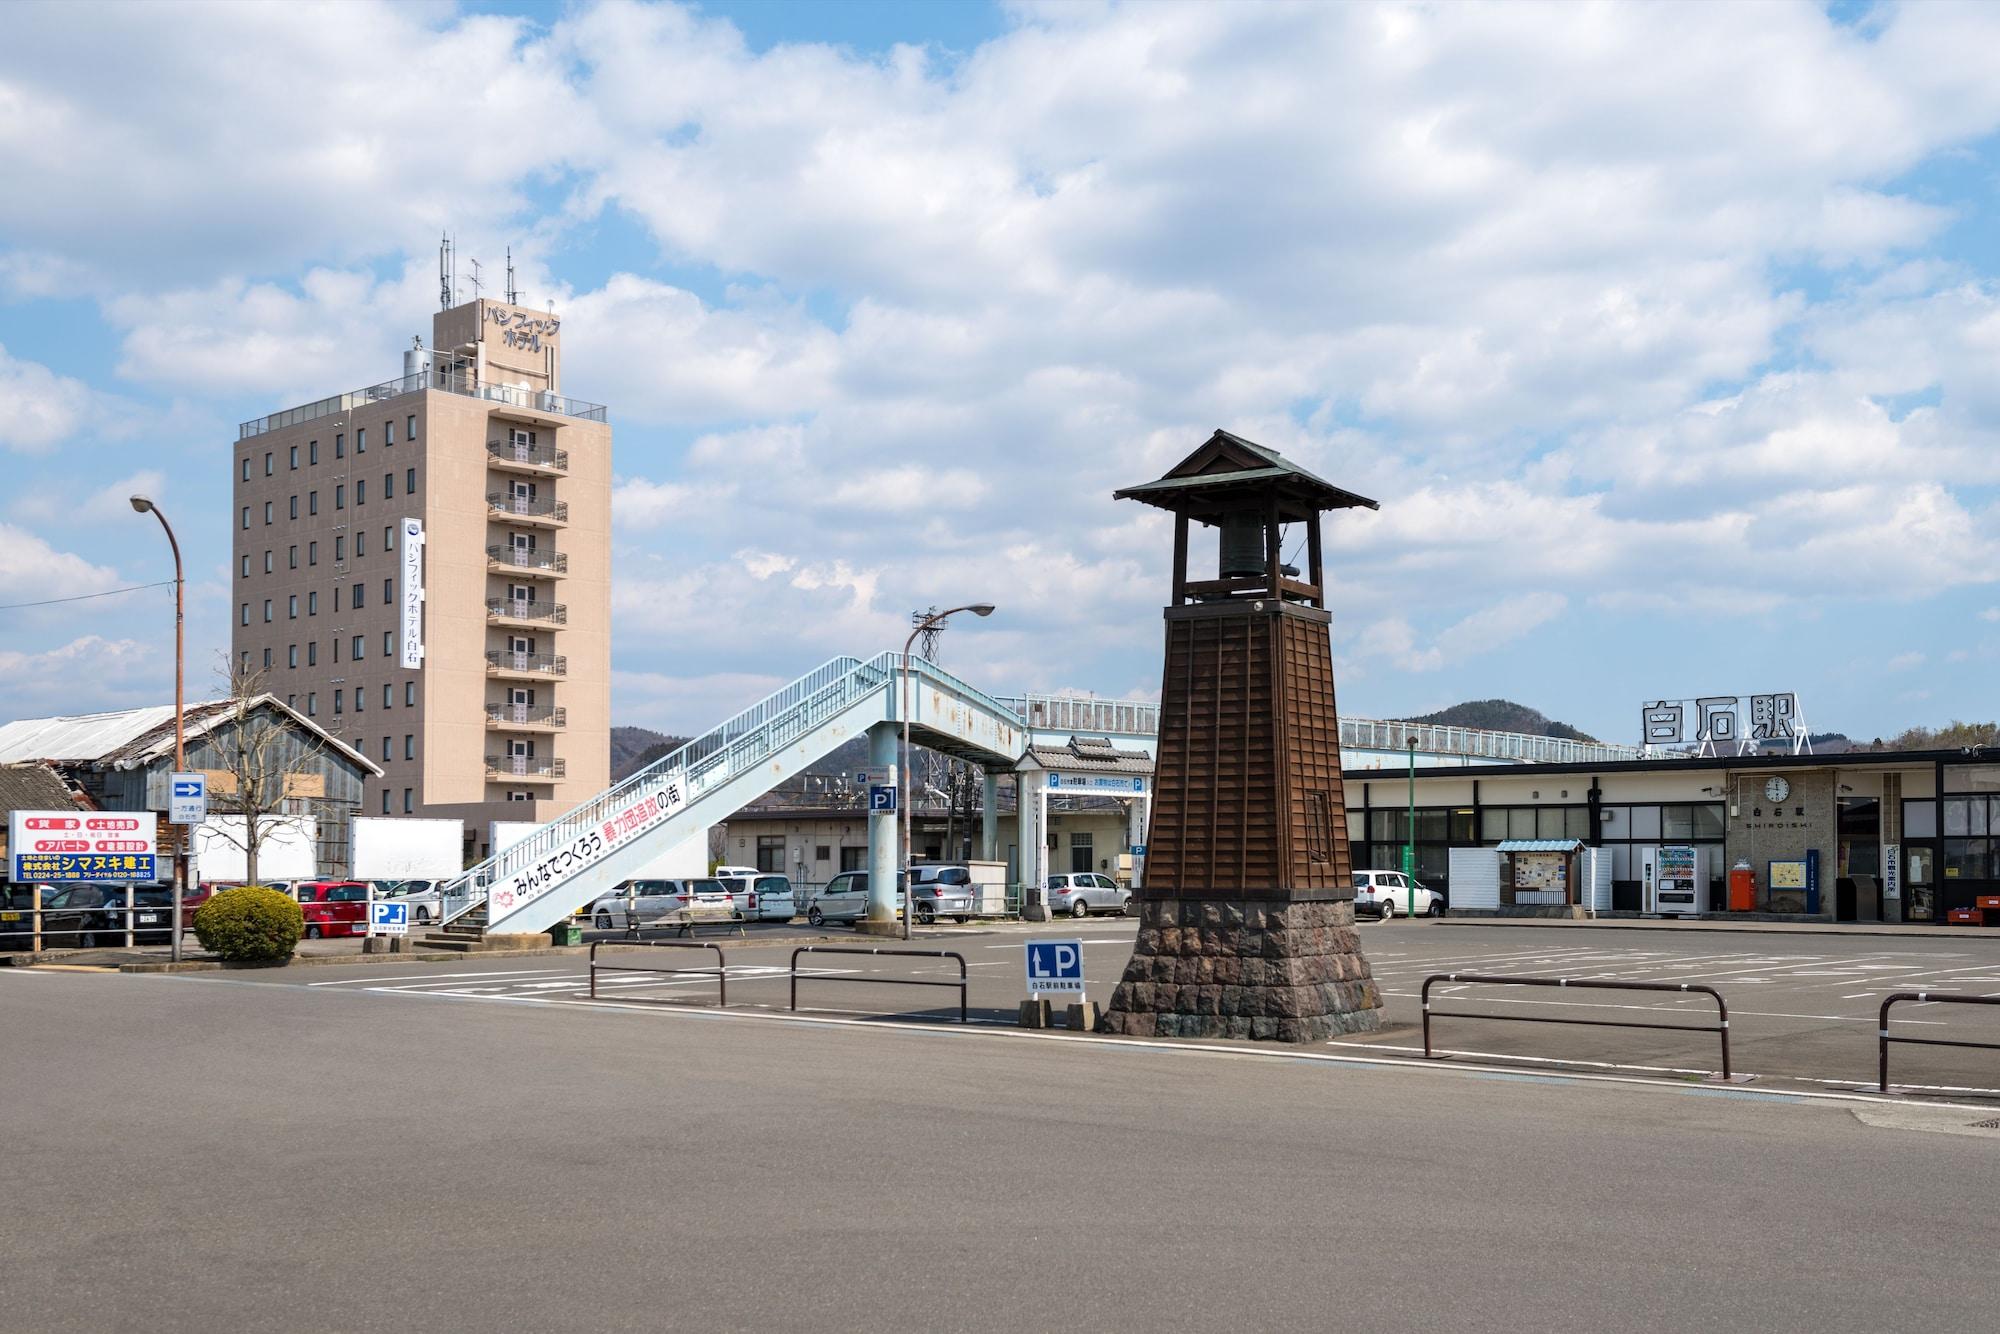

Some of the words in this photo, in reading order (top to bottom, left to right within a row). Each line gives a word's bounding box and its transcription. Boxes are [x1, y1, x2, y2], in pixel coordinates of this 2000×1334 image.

[484, 307, 560, 336] パシフィック
[503, 328, 543, 353] ホテル
[407, 543, 418, 663] パシフィックホテル白石
[1643, 693, 1795, 744] 白石駅
[874, 794, 888, 809] P
[46, 840, 86, 851] アパート
[514, 831, 602, 897] みんなでつくろう
[602, 784, 681, 843] 暴力団追放の街
[62, 856, 151, 871] シマヌキ建工
[373, 904, 390, 924] P
[1055, 945, 1076, 977] P
